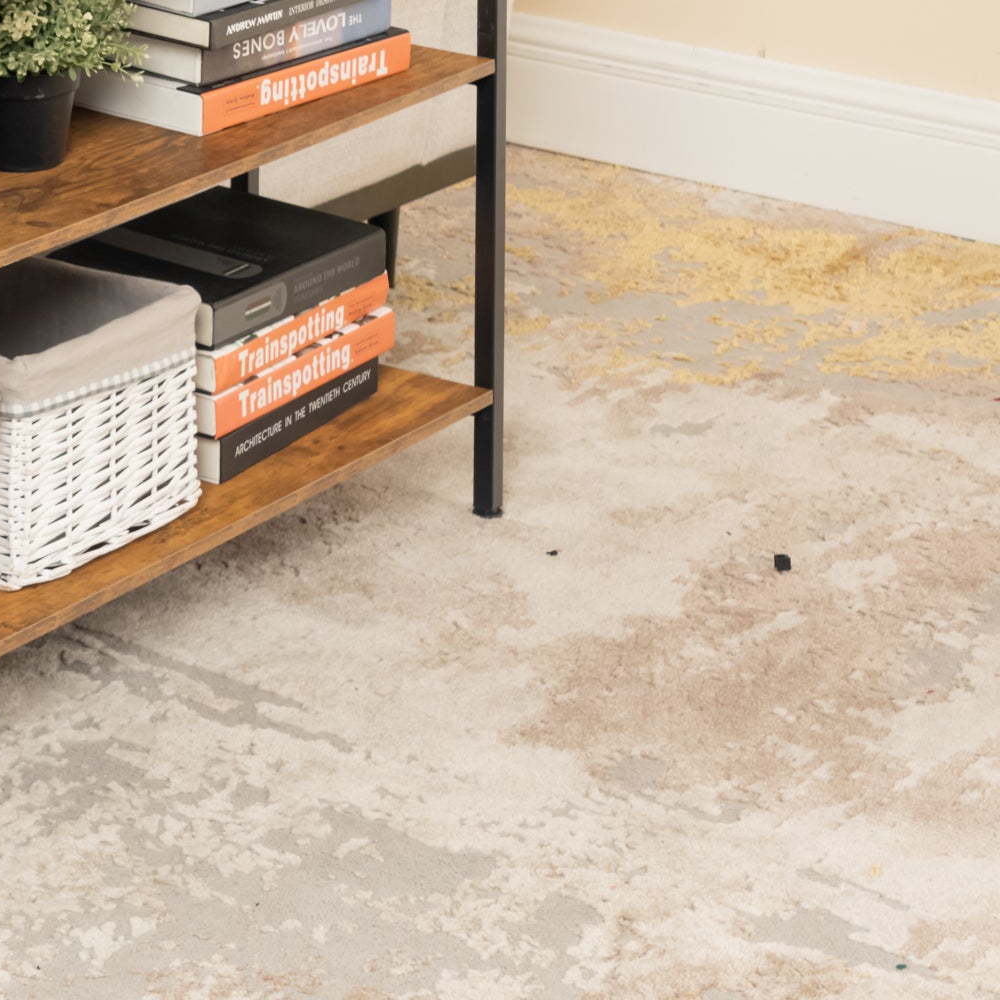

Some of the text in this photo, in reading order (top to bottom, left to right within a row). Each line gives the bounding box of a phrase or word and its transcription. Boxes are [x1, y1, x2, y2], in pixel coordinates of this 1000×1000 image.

[226, 17, 257, 36] ANDREW
[257, 9, 283, 27] MARTIN
[289, 1, 315, 16] INTERIOR
[288, 12, 346, 44] LOVELY
[348, 14, 362, 26] THE
[232, 29, 285, 60] BONES
[234, 368, 372, 458] ARCHITECTURE IN THE TWENTIETH CENTURY
